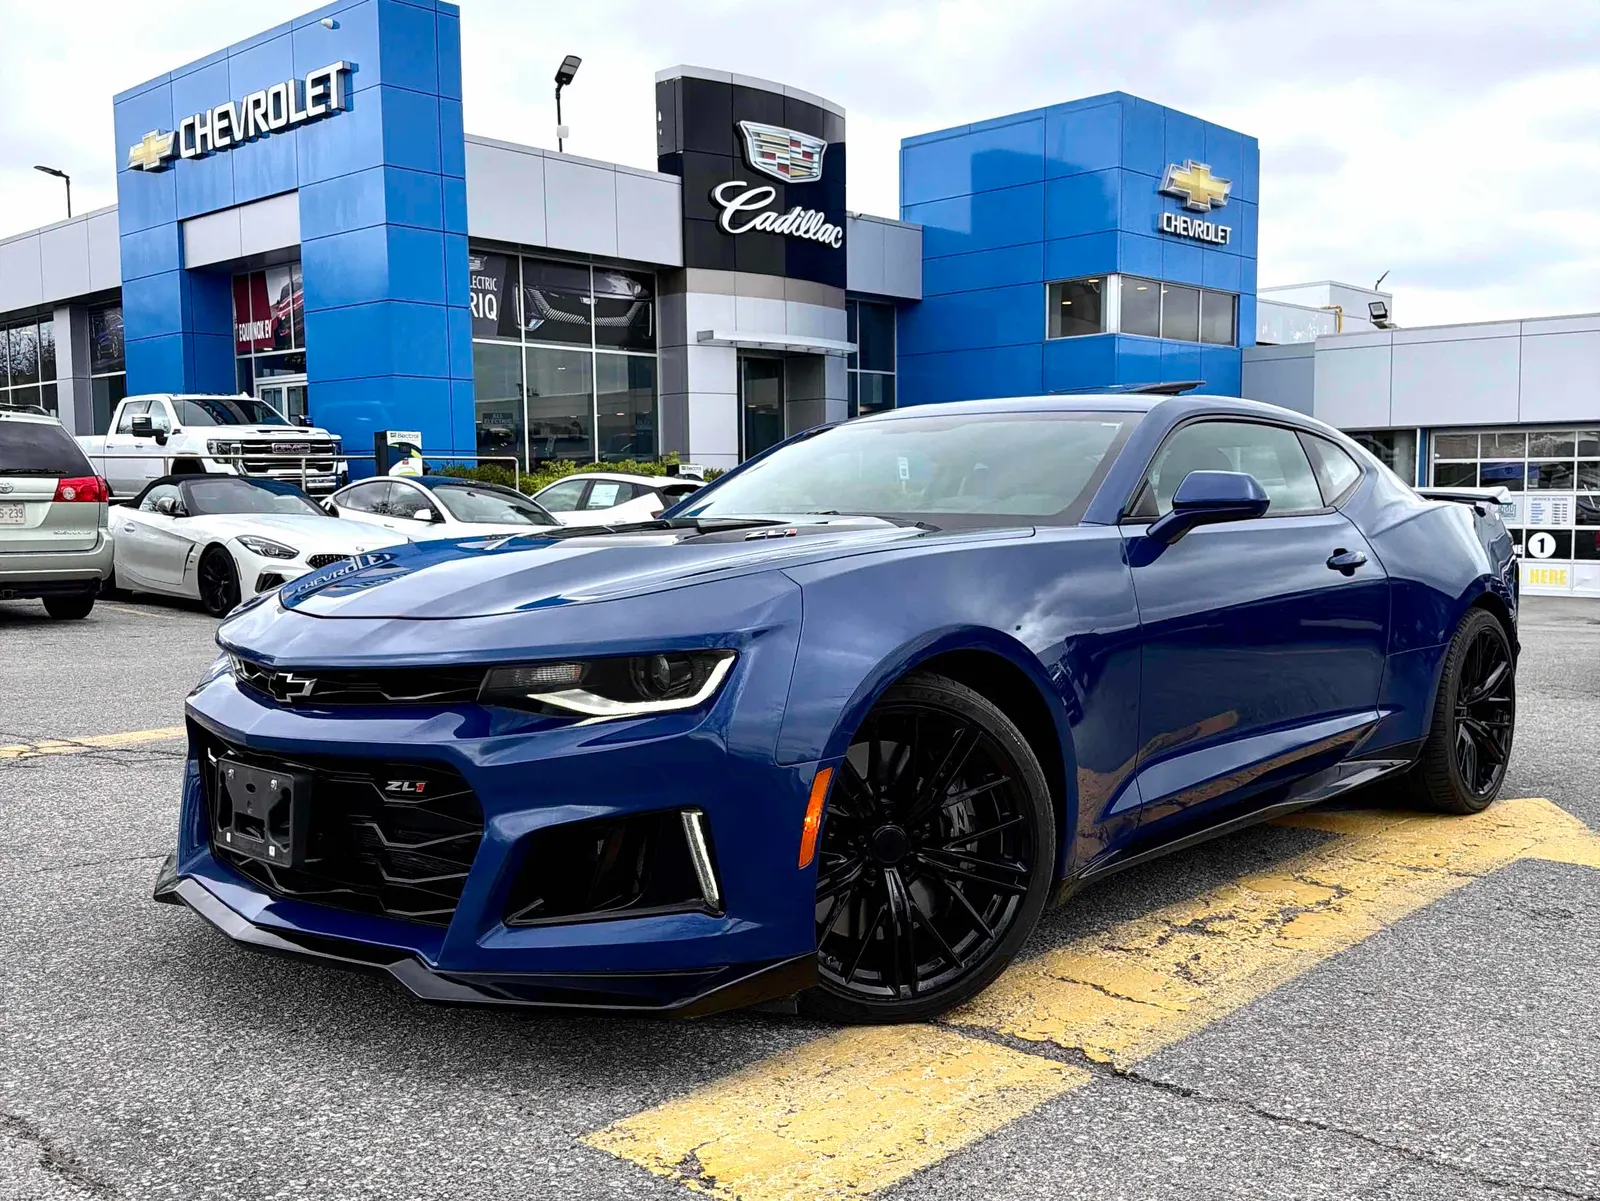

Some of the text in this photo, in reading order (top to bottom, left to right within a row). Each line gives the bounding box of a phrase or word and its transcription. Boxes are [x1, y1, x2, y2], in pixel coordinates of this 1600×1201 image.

[179, 60, 346, 159] CHEVROLET
[714, 181, 843, 248] Cadillac
[1163, 212, 1232, 244] CHEVROLET
[8, 508, 24, 518] 239
[745, 528, 797, 541] ZL1
[1537, 538, 1545, 553] 1
[1529, 568, 1567, 585] HERE
[385, 781, 426, 792] ZL1
